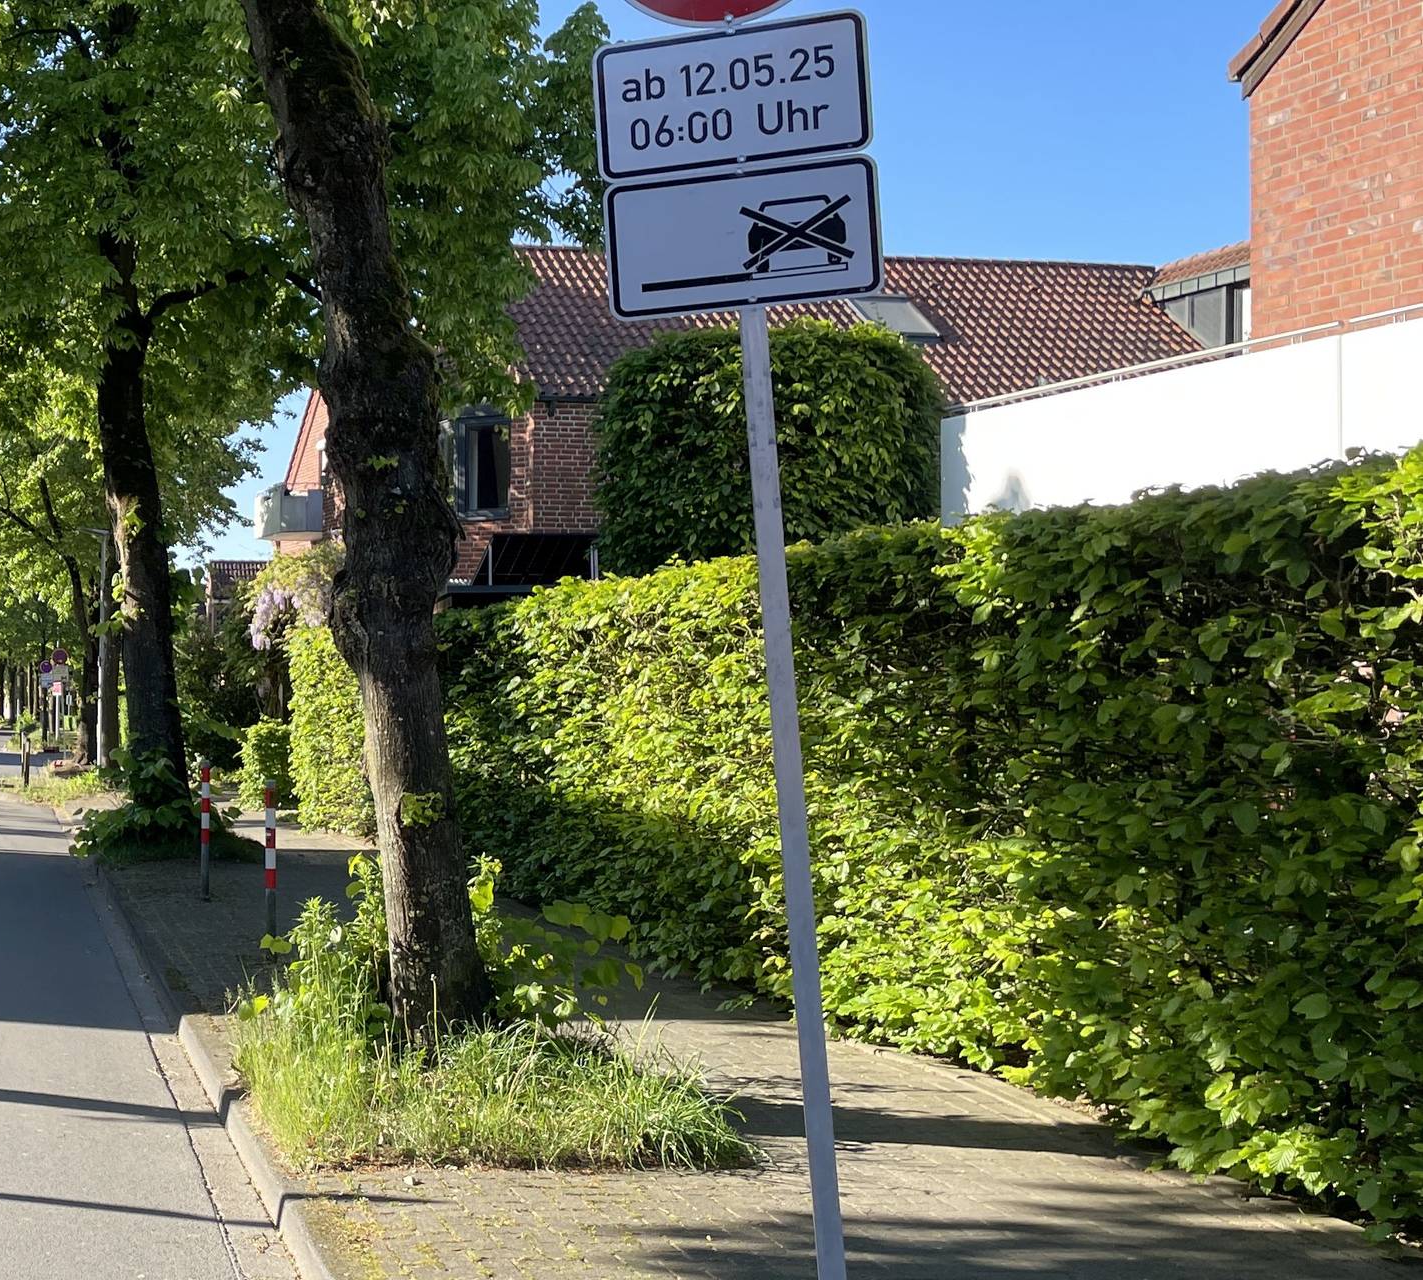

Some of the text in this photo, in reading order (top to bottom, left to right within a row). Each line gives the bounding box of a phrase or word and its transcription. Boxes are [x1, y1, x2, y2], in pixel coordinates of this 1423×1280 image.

[621, 44, 835, 102] ab 12.05.25
[630, 100, 830, 150] 06:00 Uhr
